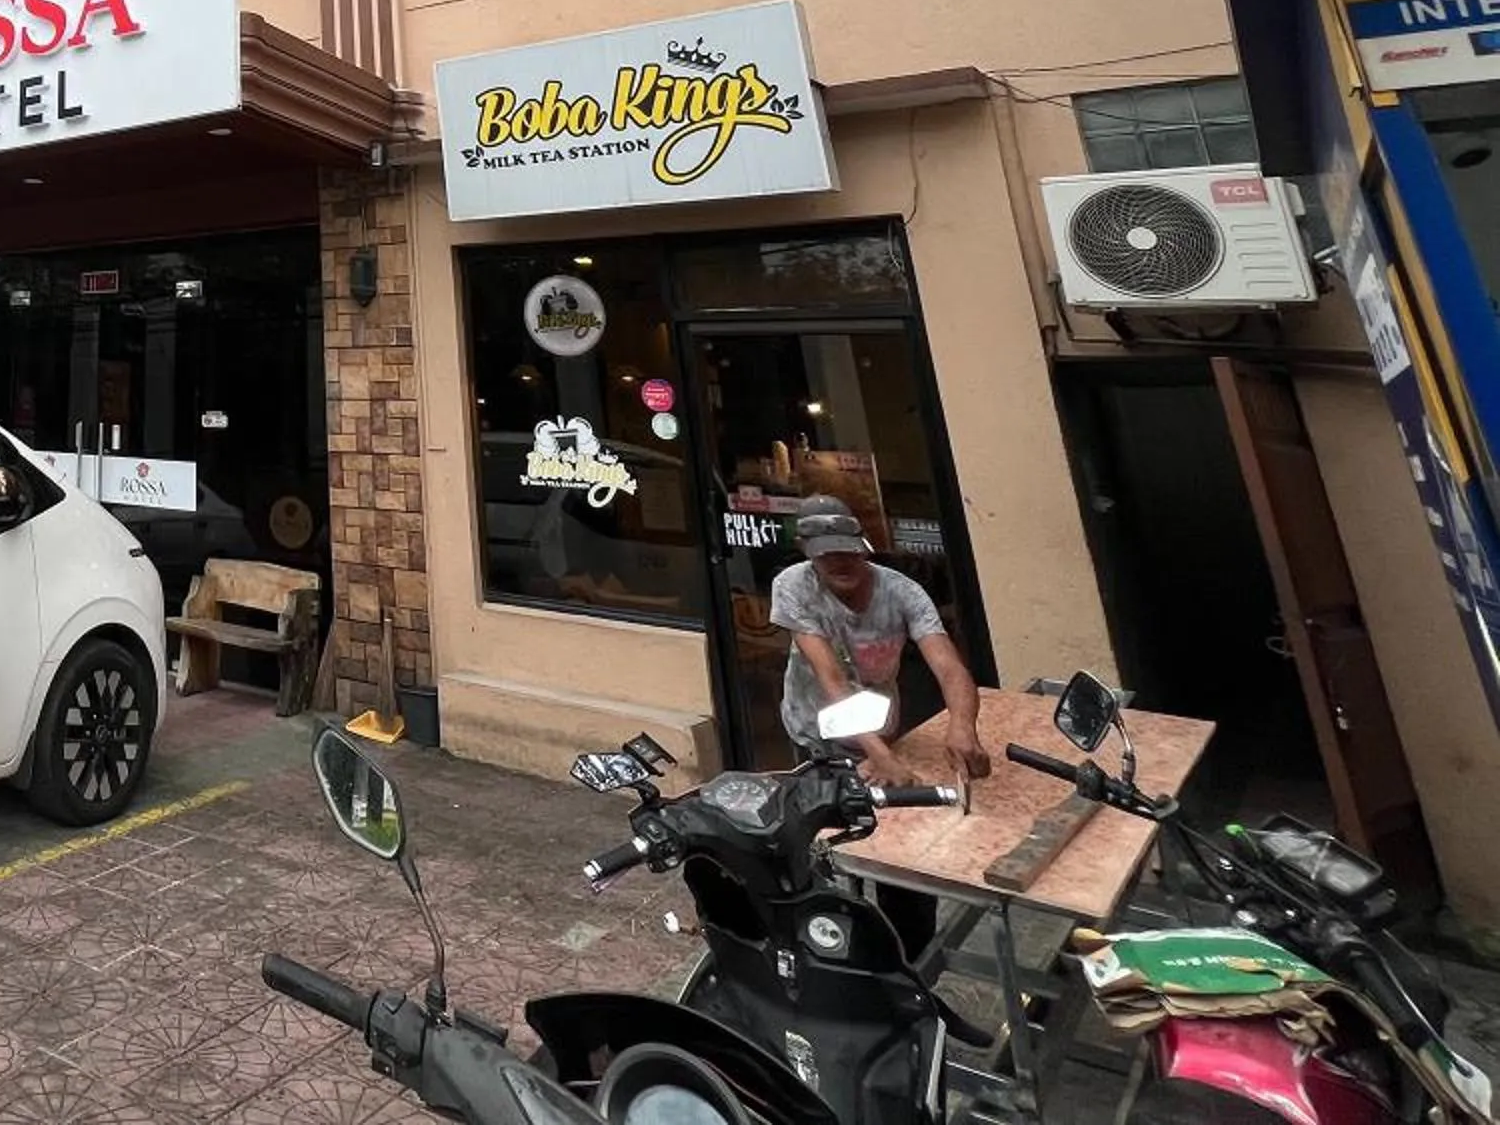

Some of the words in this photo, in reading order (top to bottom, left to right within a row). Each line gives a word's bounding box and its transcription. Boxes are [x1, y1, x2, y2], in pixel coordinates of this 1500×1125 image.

[475, 80, 608, 147] Boba
[611, 63, 792, 186] Kings
[483, 155, 526, 169] MILK
[529, 150, 565, 164] TEA
[568, 139, 651, 160] STATION
[1219, 185, 1261, 197] TCL
[120, 476, 168, 497] ROSSA
[724, 512, 756, 530] PULL
